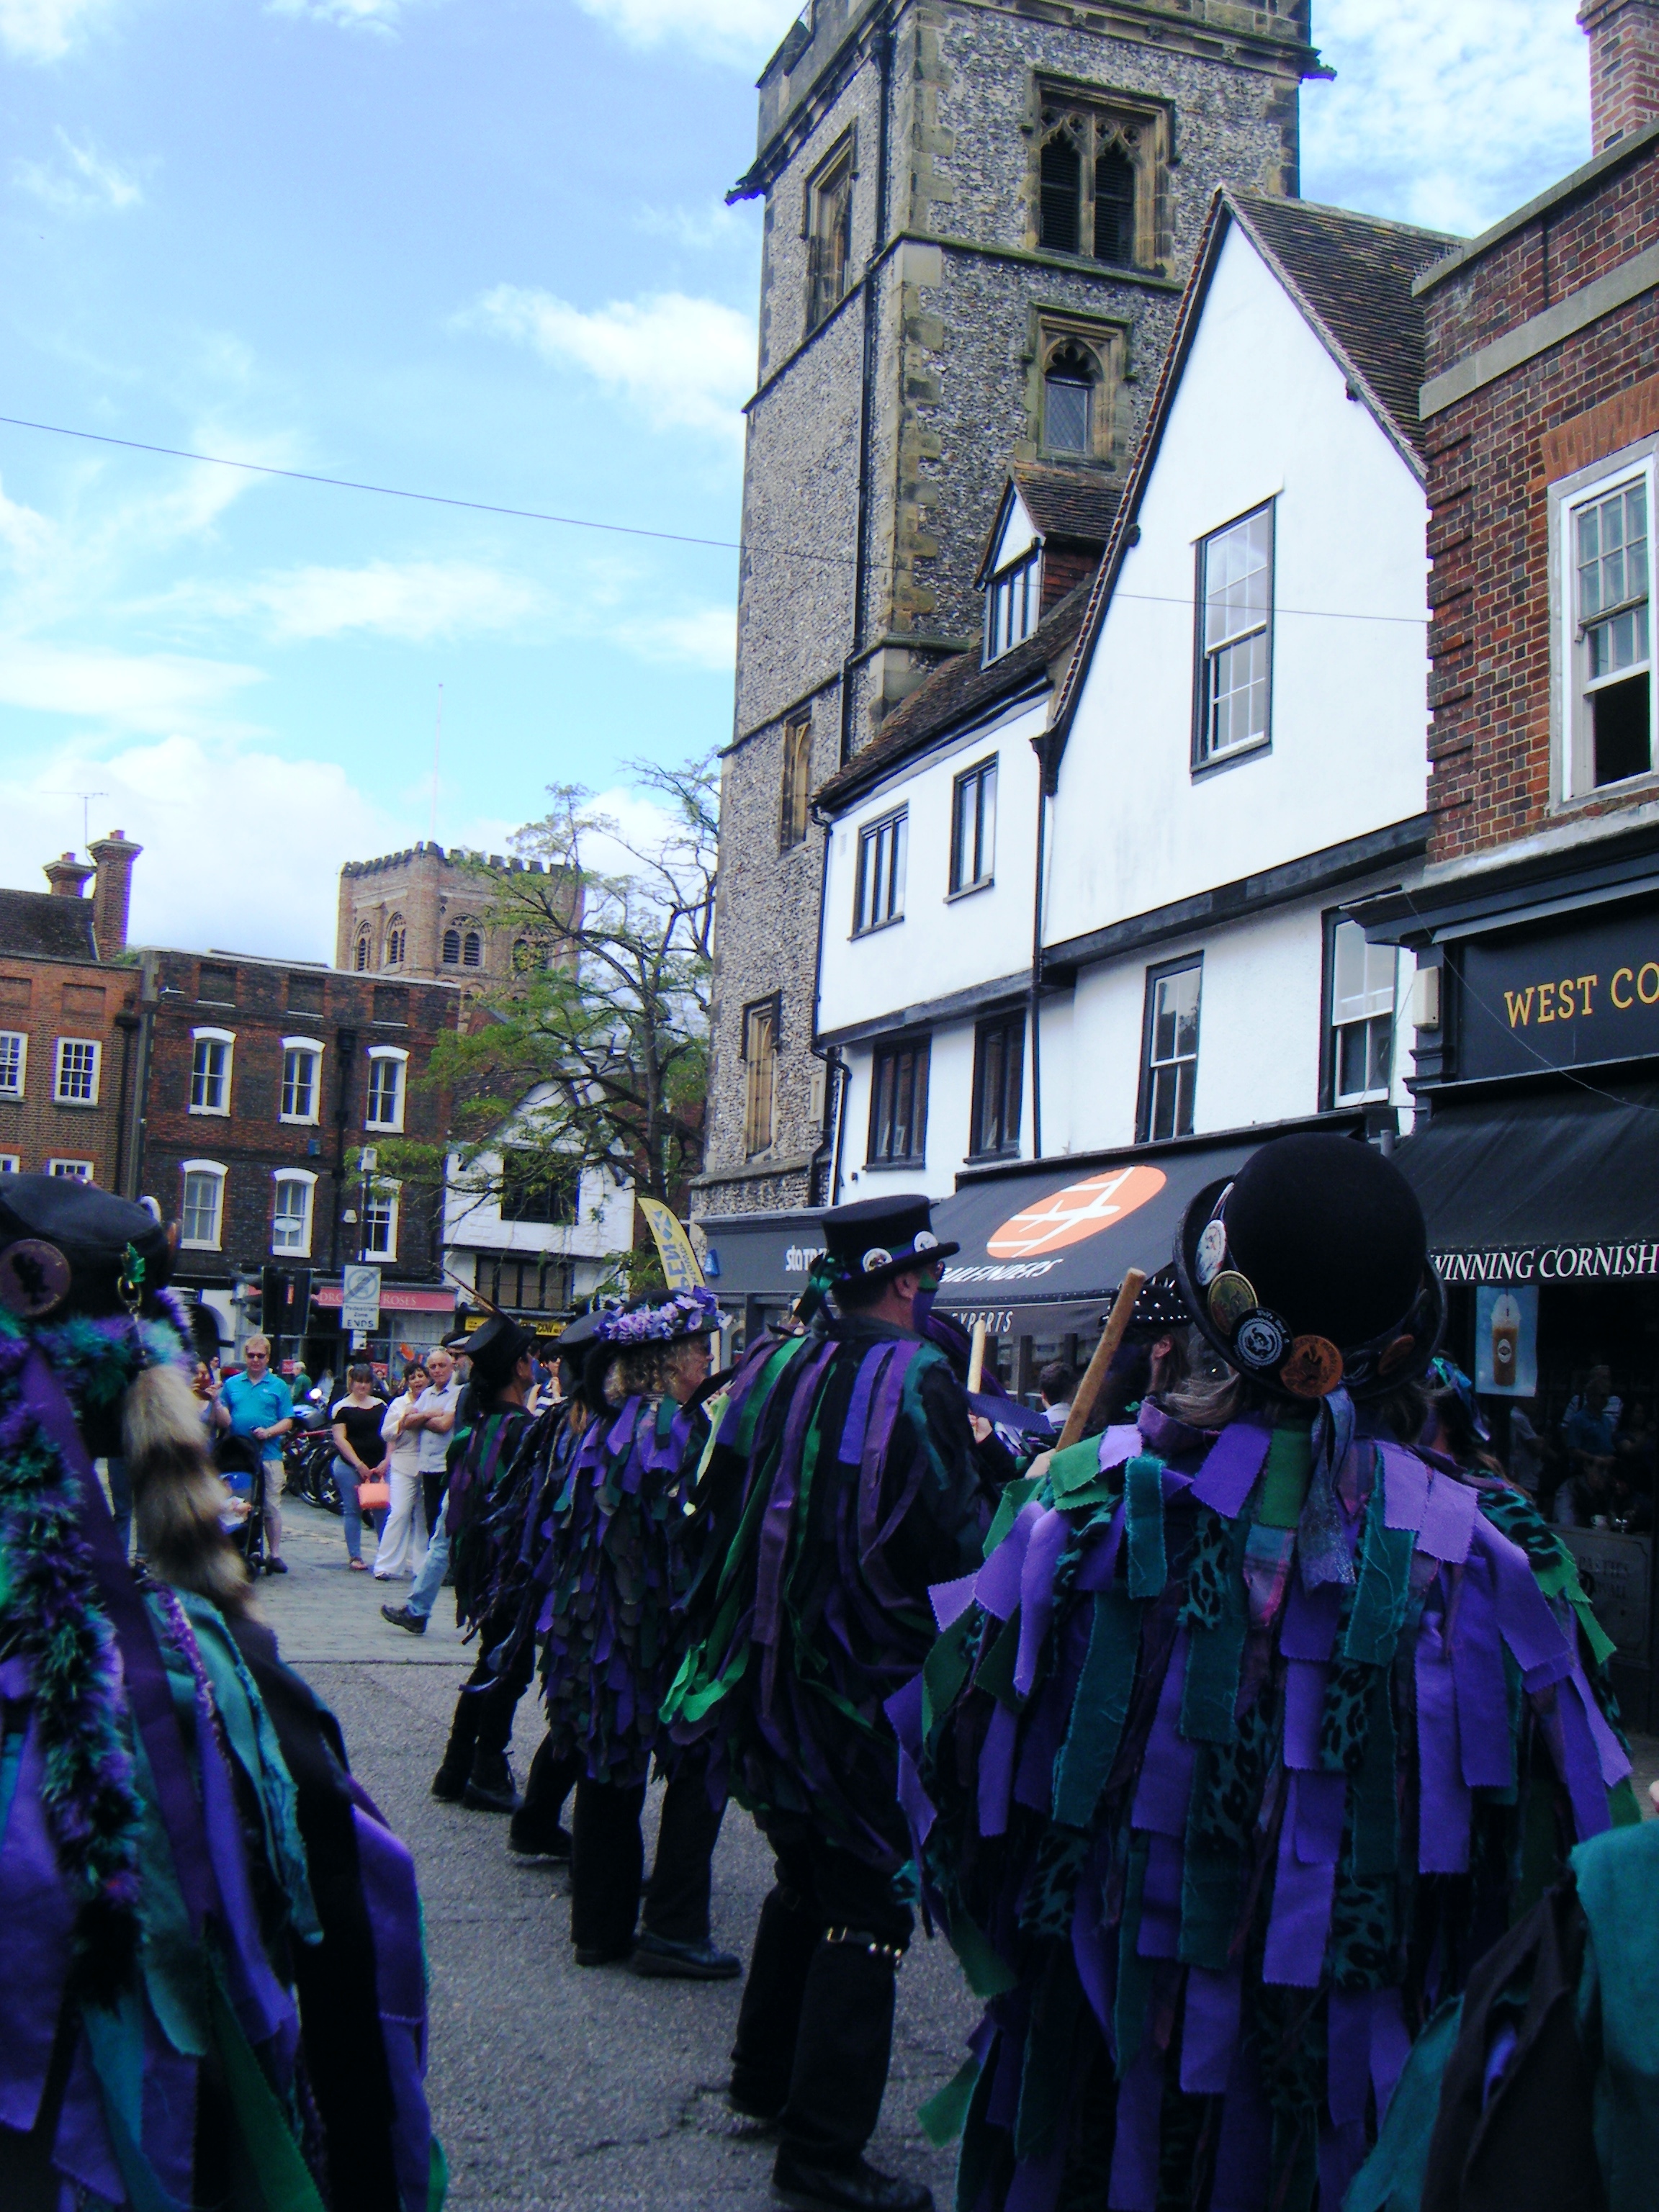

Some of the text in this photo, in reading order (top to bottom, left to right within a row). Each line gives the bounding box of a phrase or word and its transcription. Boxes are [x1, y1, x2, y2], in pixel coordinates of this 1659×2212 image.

[1503, 961, 1659, 1028] WEST CO
[1539, 1243, 1659, 1278] CORNISH
[347, 1319, 374, 1328] ENDS
[951, 1310, 1014, 1333] XPRTS
